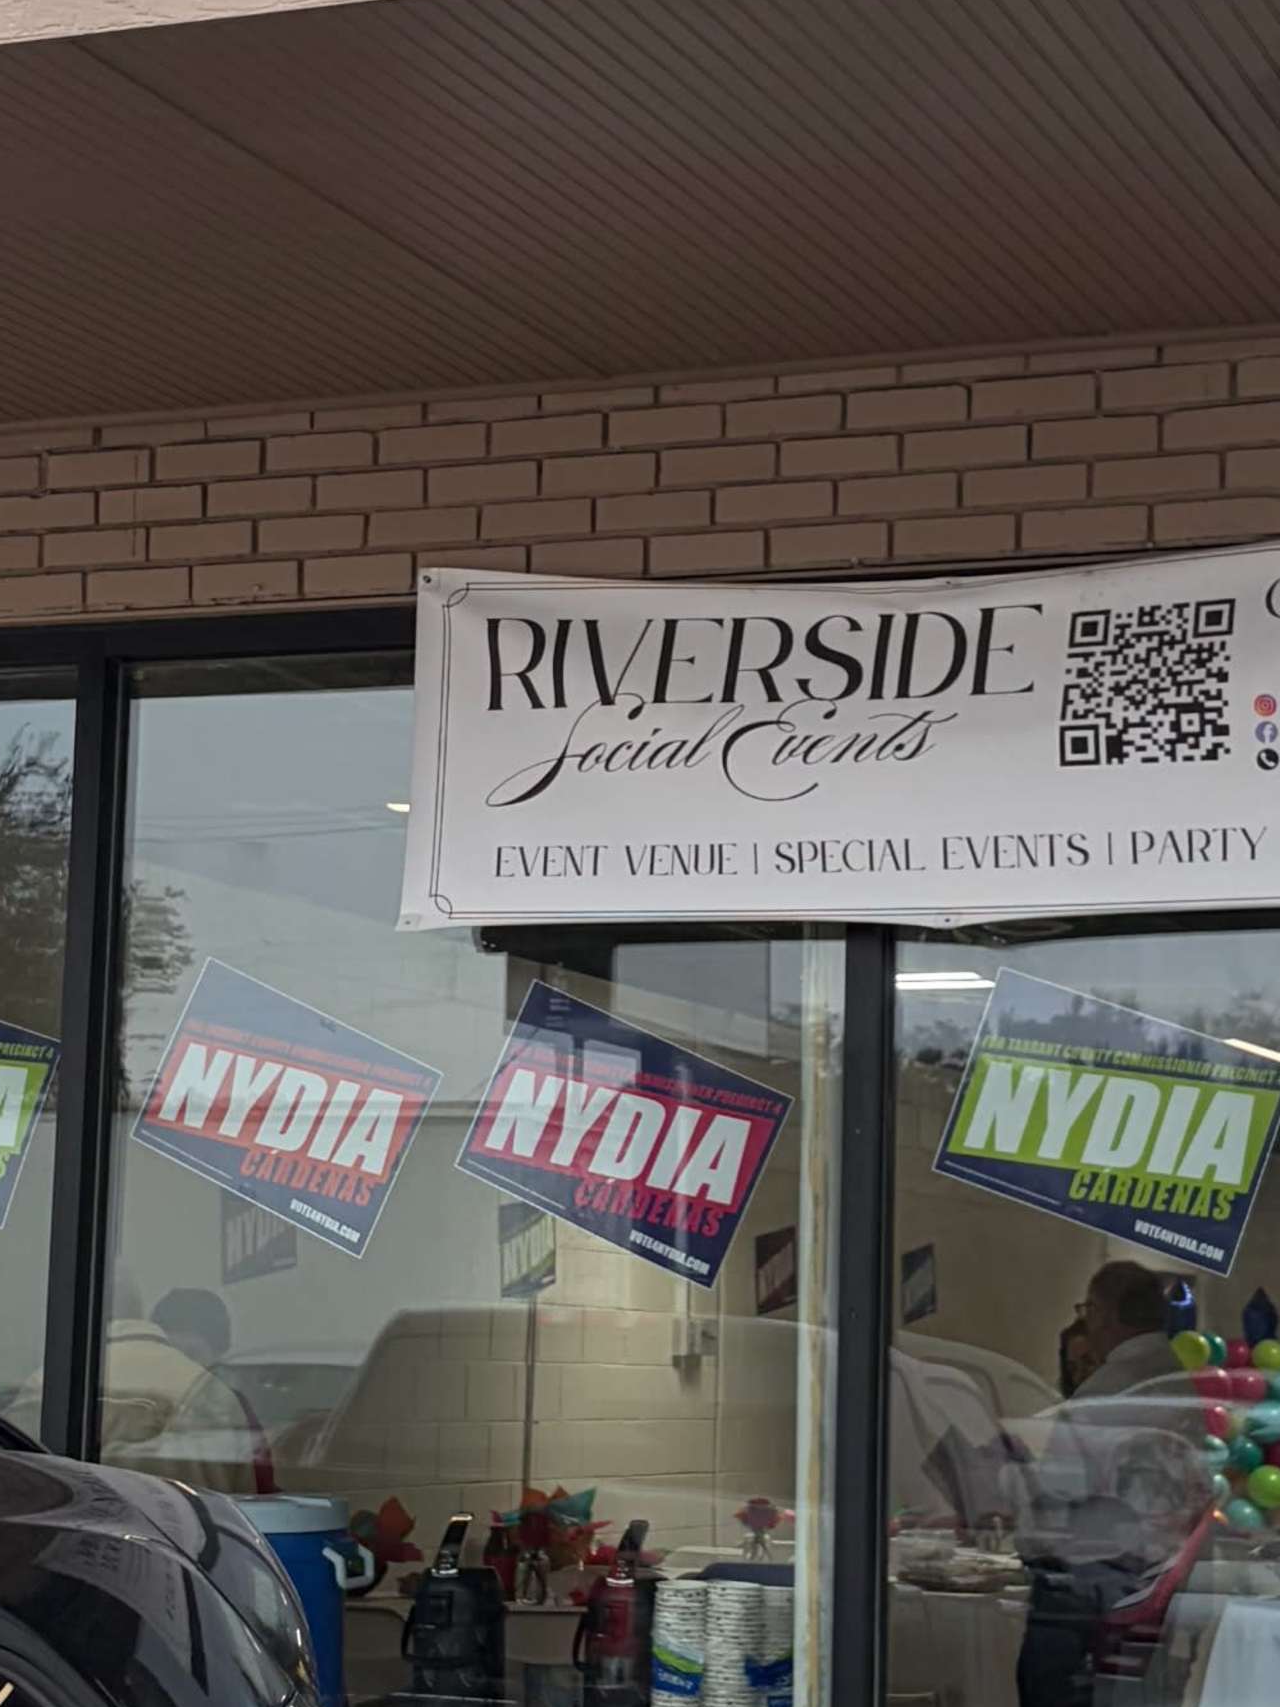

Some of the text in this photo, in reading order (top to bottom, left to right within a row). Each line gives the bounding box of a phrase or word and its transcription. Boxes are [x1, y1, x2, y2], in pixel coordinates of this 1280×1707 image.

[485, 603, 1043, 711] RIVERSIDE
[485, 692, 958, 807] Social Events
[495, 844, 608, 878] EVENT
[625, 842, 738, 876] VENUE
[775, 838, 926, 875] SPECIAL
[942, 832, 1090, 871] EVENTS
[1131, 826, 1268, 865] PARTY
[158, 1042, 404, 1176] NYDIA
[485, 1068, 752, 1206] NYDIA
[963, 1060, 1255, 1186] NYDIA
